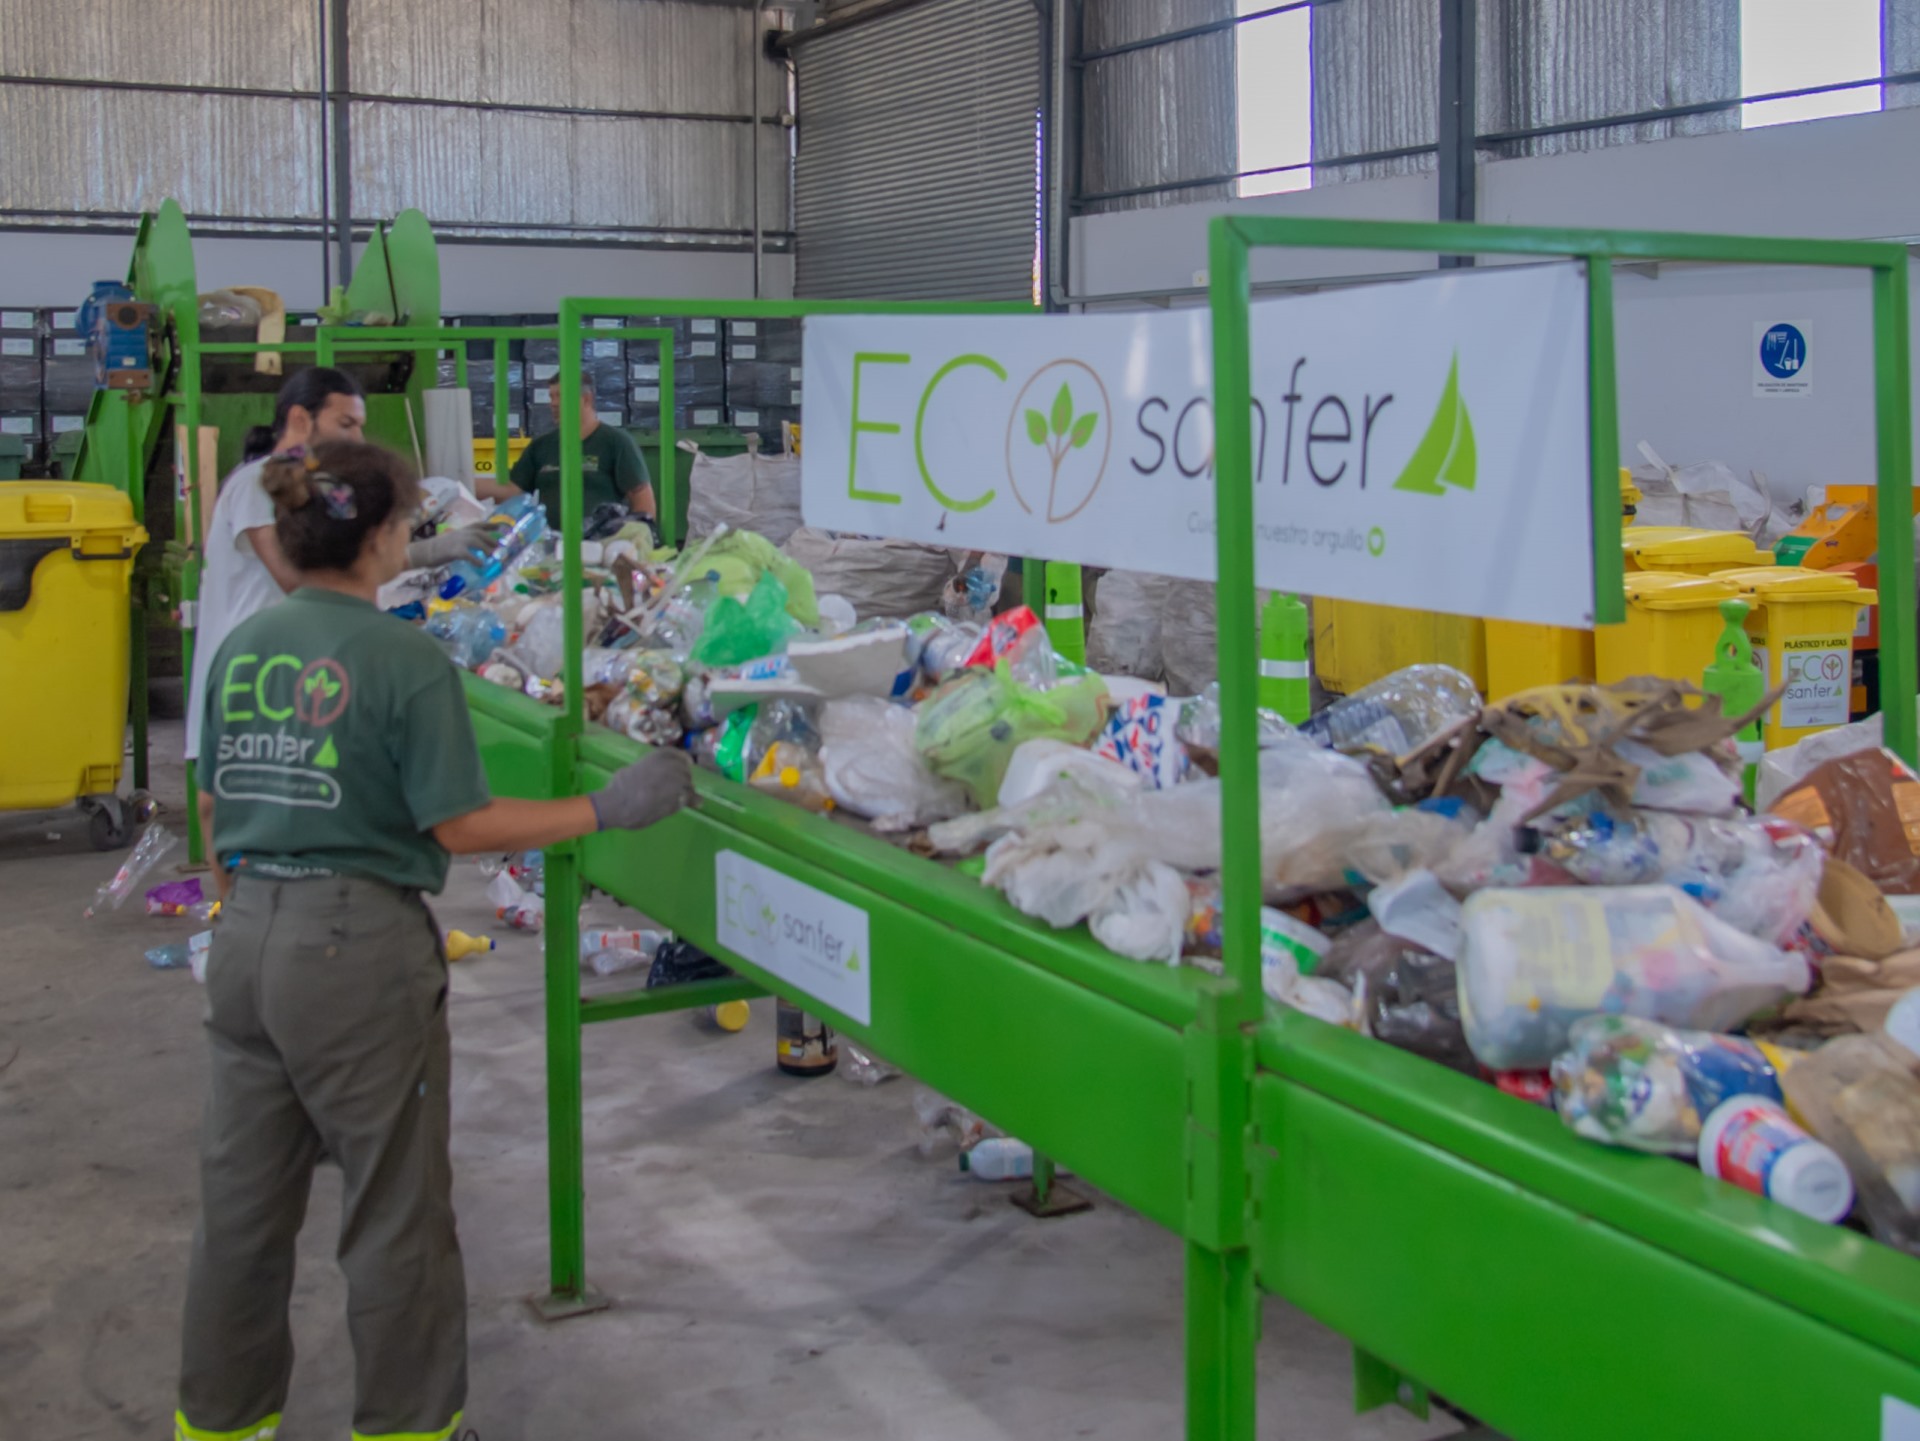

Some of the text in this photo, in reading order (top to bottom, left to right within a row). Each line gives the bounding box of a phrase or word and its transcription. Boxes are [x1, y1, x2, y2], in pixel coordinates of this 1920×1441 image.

[848, 351, 1393, 523] ECO sanfer
[1312, 525, 1364, 554] orgullo
[221, 654, 350, 727] ECO
[1787, 684, 1832, 699] sanfer
